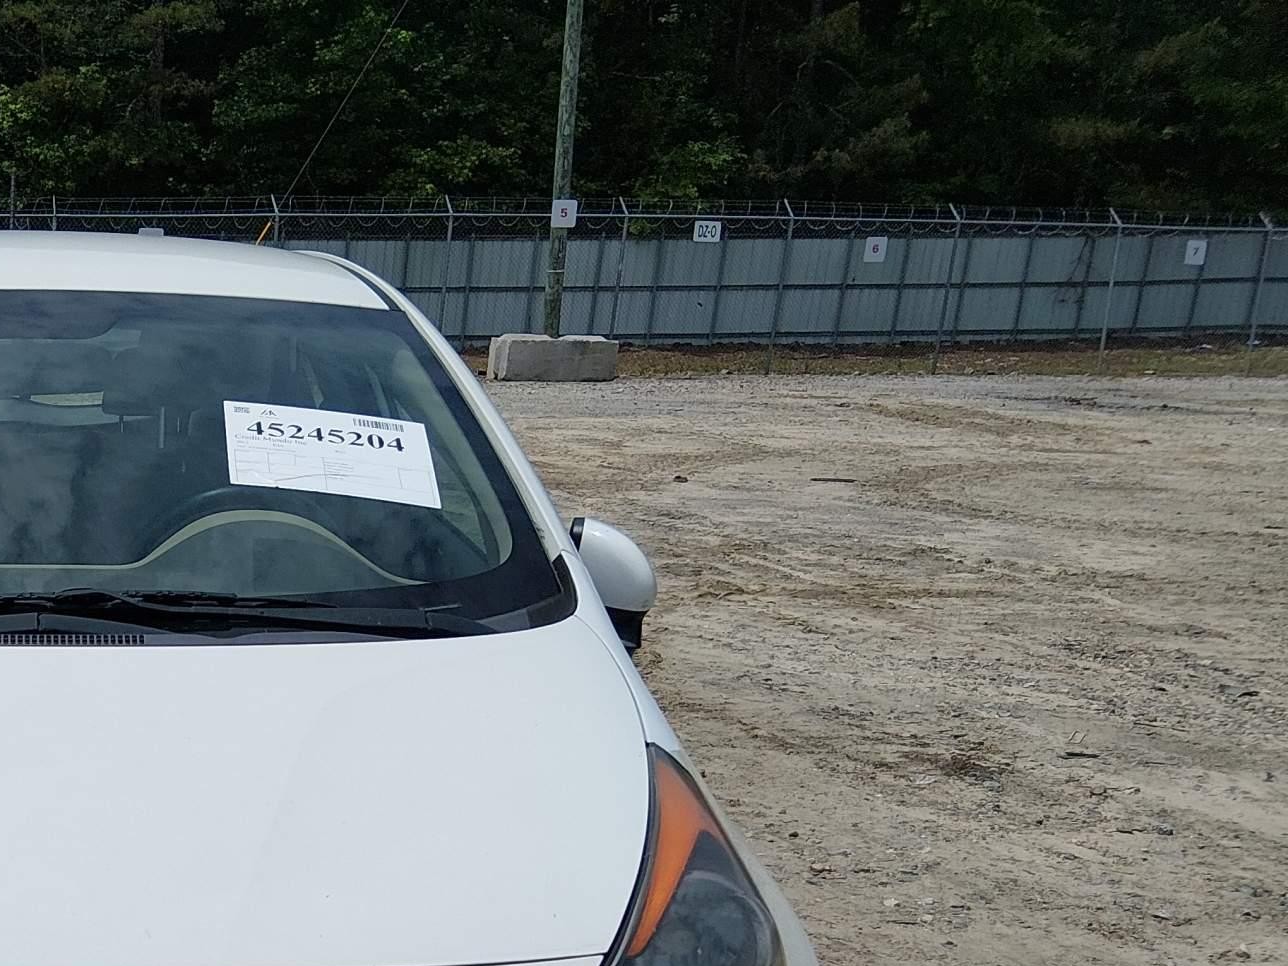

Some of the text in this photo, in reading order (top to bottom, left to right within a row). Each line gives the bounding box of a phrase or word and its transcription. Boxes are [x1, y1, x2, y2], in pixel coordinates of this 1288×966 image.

[560, 207, 568, 218] 5
[872, 244, 880, 254] 6
[1192, 246, 1201, 257] 7
[246, 420, 405, 453] 45245204
